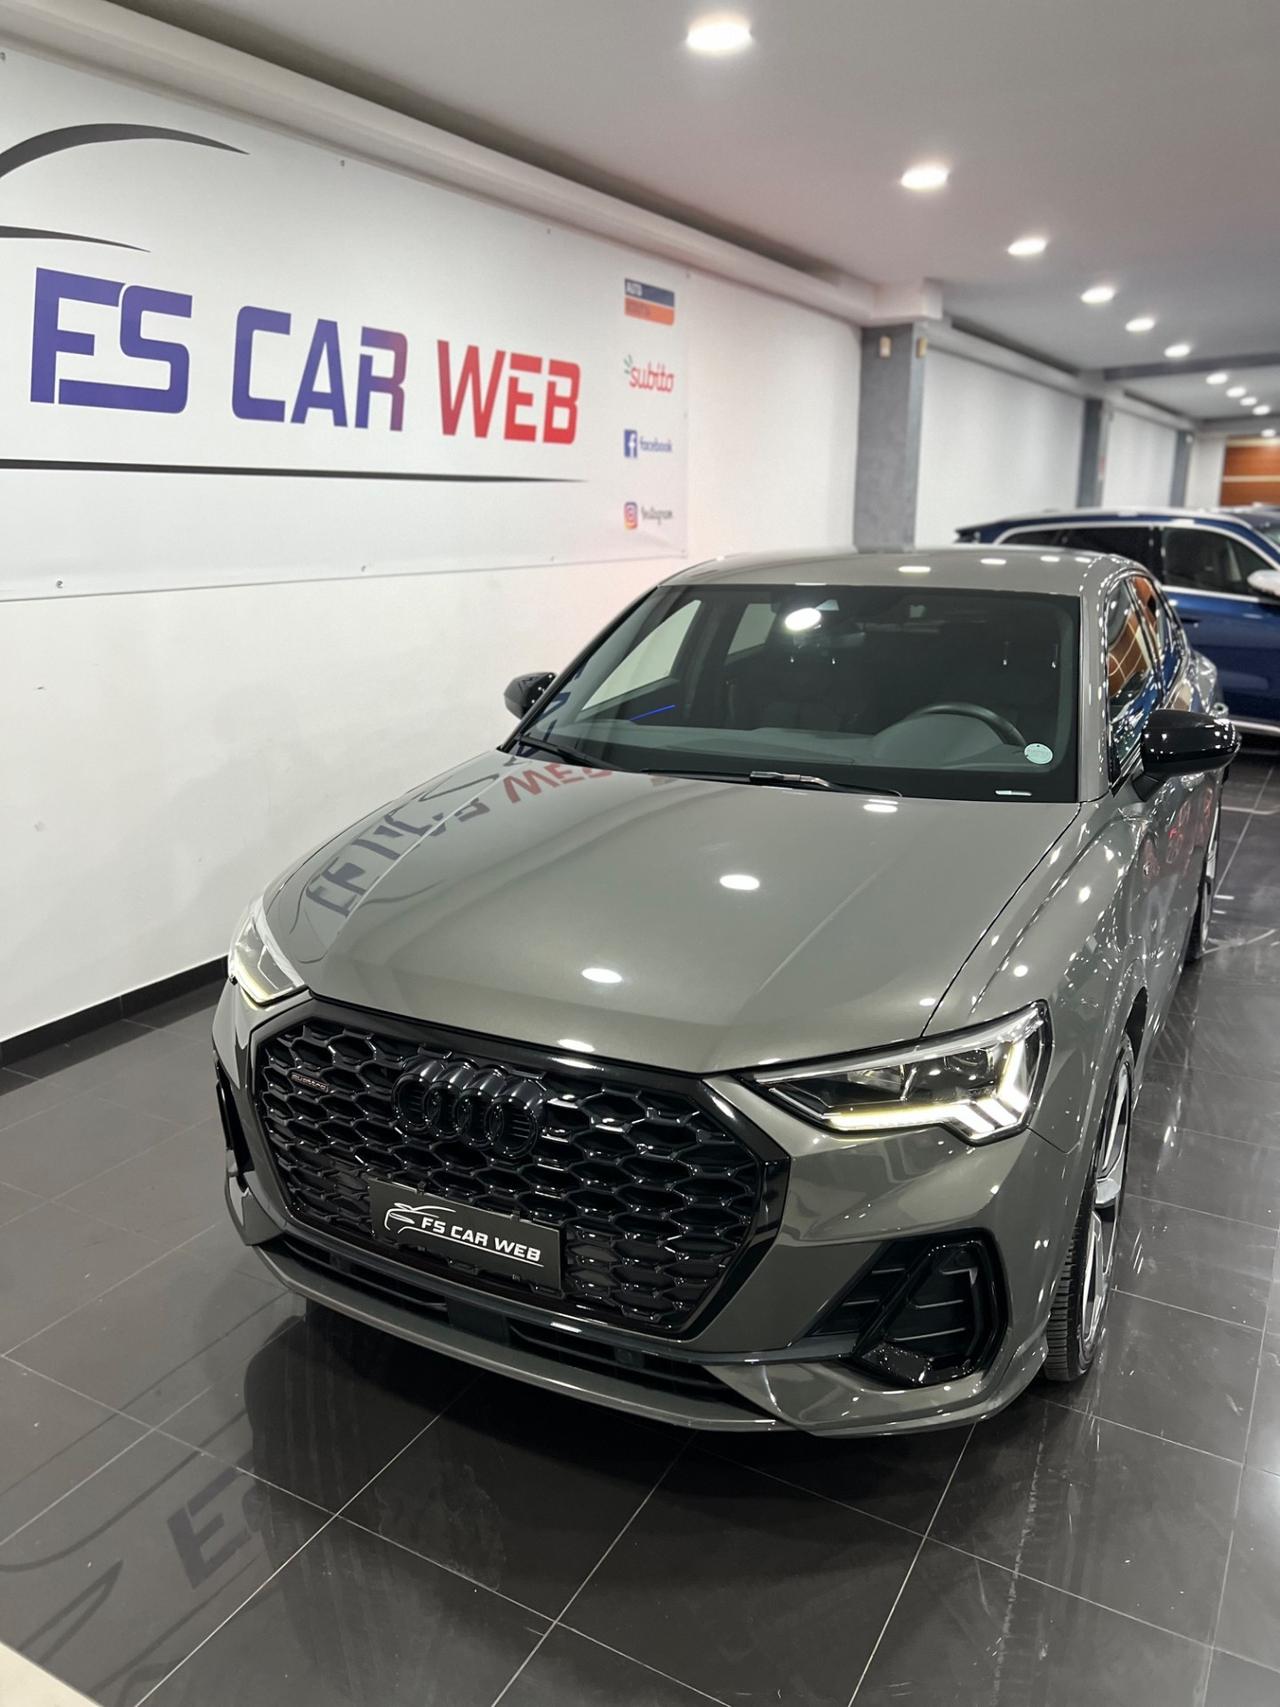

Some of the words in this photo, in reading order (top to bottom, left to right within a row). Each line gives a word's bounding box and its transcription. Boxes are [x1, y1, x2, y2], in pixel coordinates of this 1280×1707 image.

[30, 267, 193, 414] FS
[231, 305, 408, 432] CAR
[437, 339, 581, 445] WEB
[421, 1216, 446, 1234] FS
[450, 1225, 489, 1247] CAR
[494, 1237, 541, 1262] WEB
